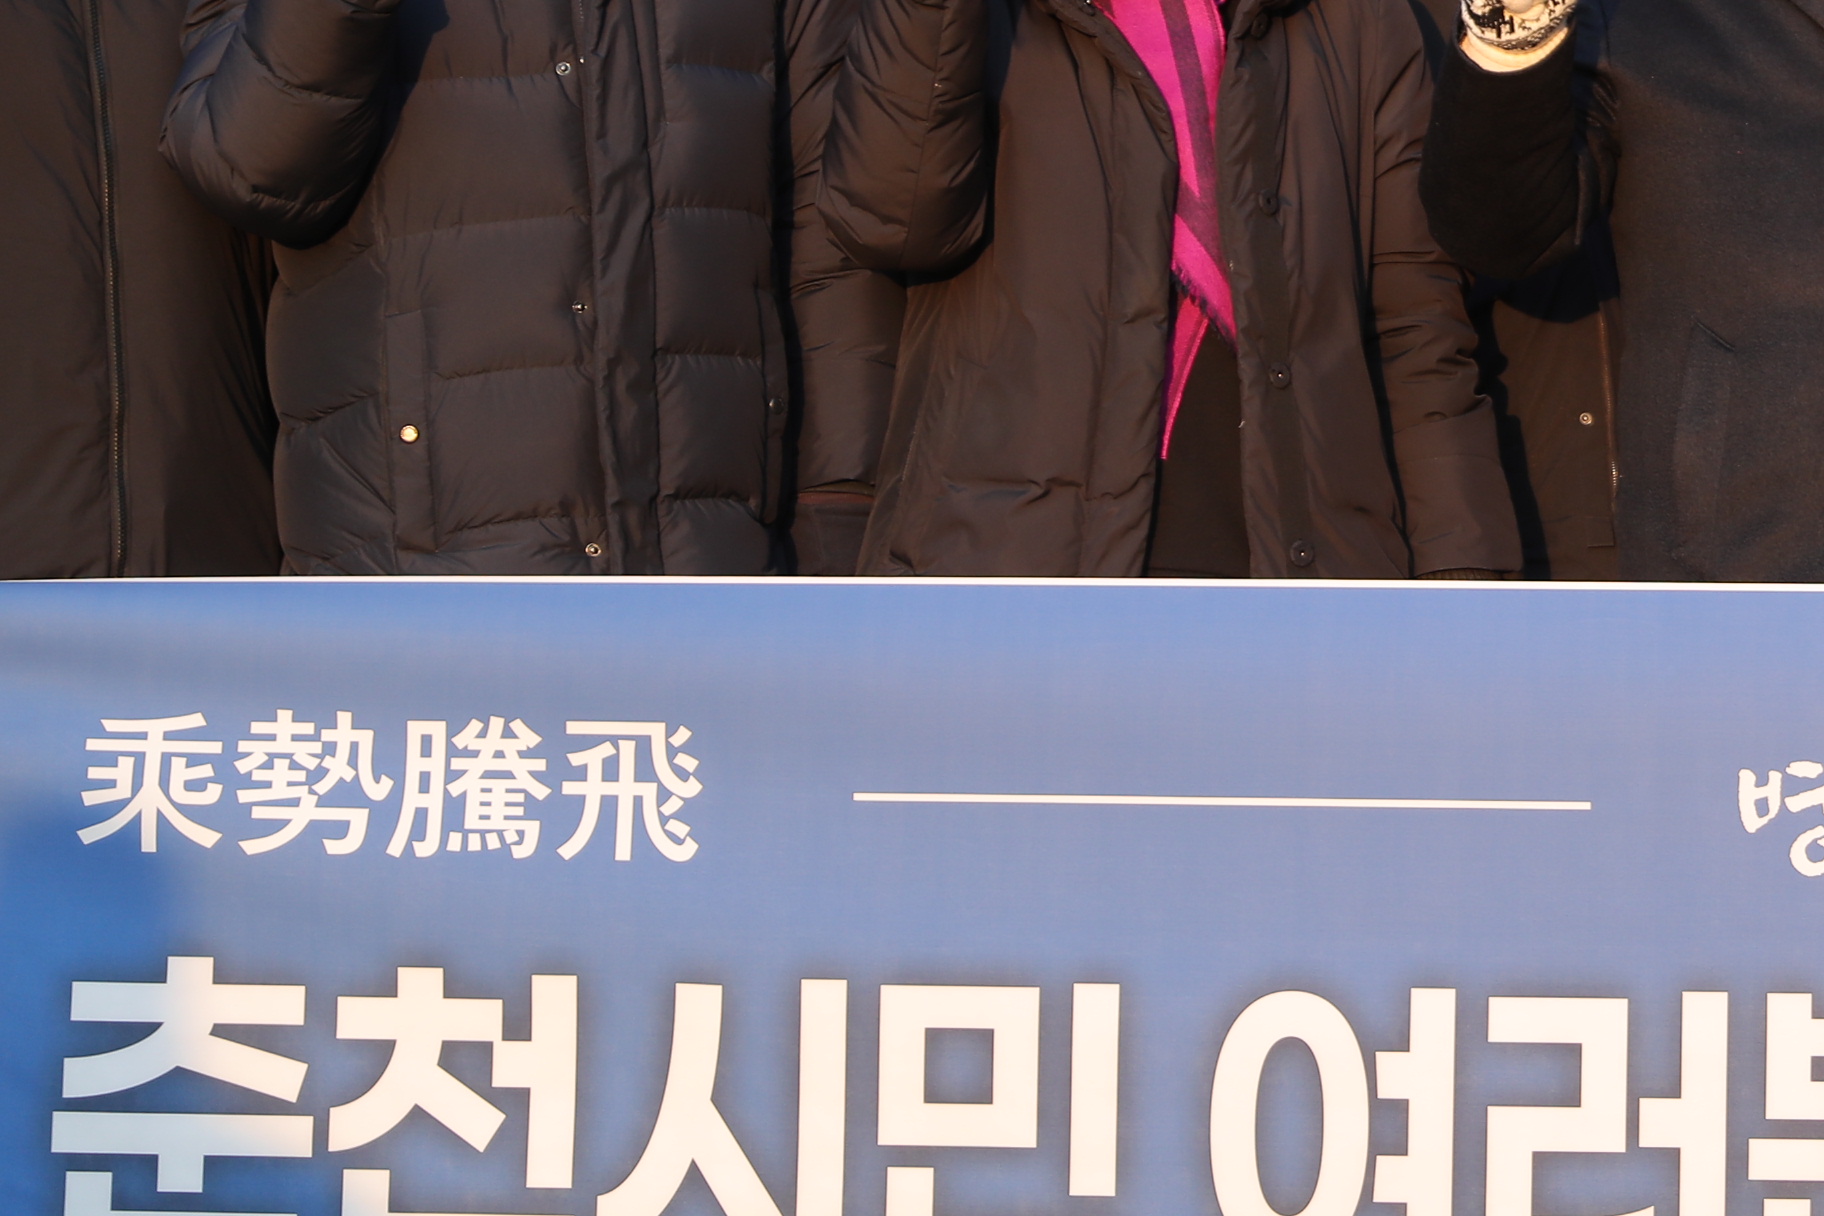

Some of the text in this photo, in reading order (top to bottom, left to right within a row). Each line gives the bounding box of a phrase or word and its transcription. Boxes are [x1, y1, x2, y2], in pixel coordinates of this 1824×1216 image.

[77, 709, 703, 862] 乘勢騰飛
[51, 956, 1120, 1216] 춘천시민
